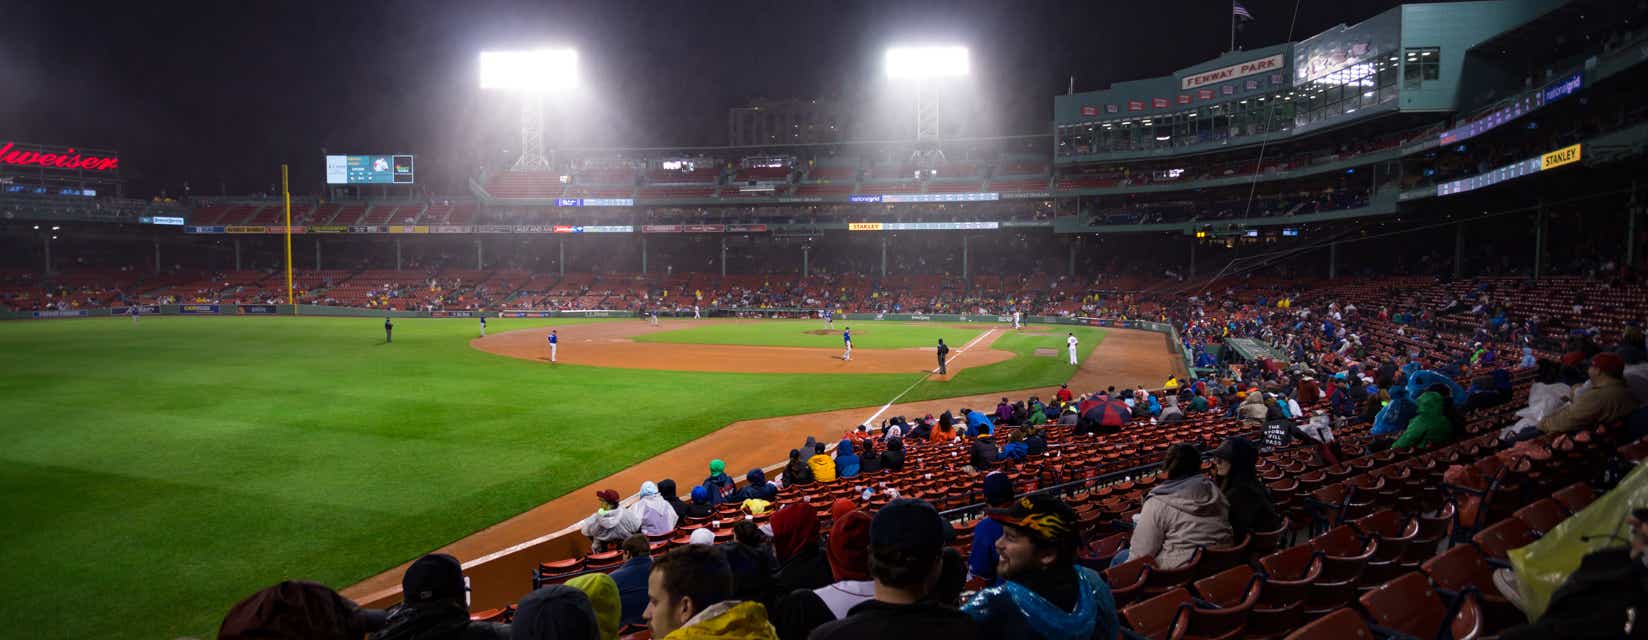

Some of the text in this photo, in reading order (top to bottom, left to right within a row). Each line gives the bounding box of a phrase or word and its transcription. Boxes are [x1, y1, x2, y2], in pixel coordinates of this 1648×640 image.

[1186, 59, 1275, 87] FENWAY PARK
[1546, 148, 1577, 167] STANLEY
